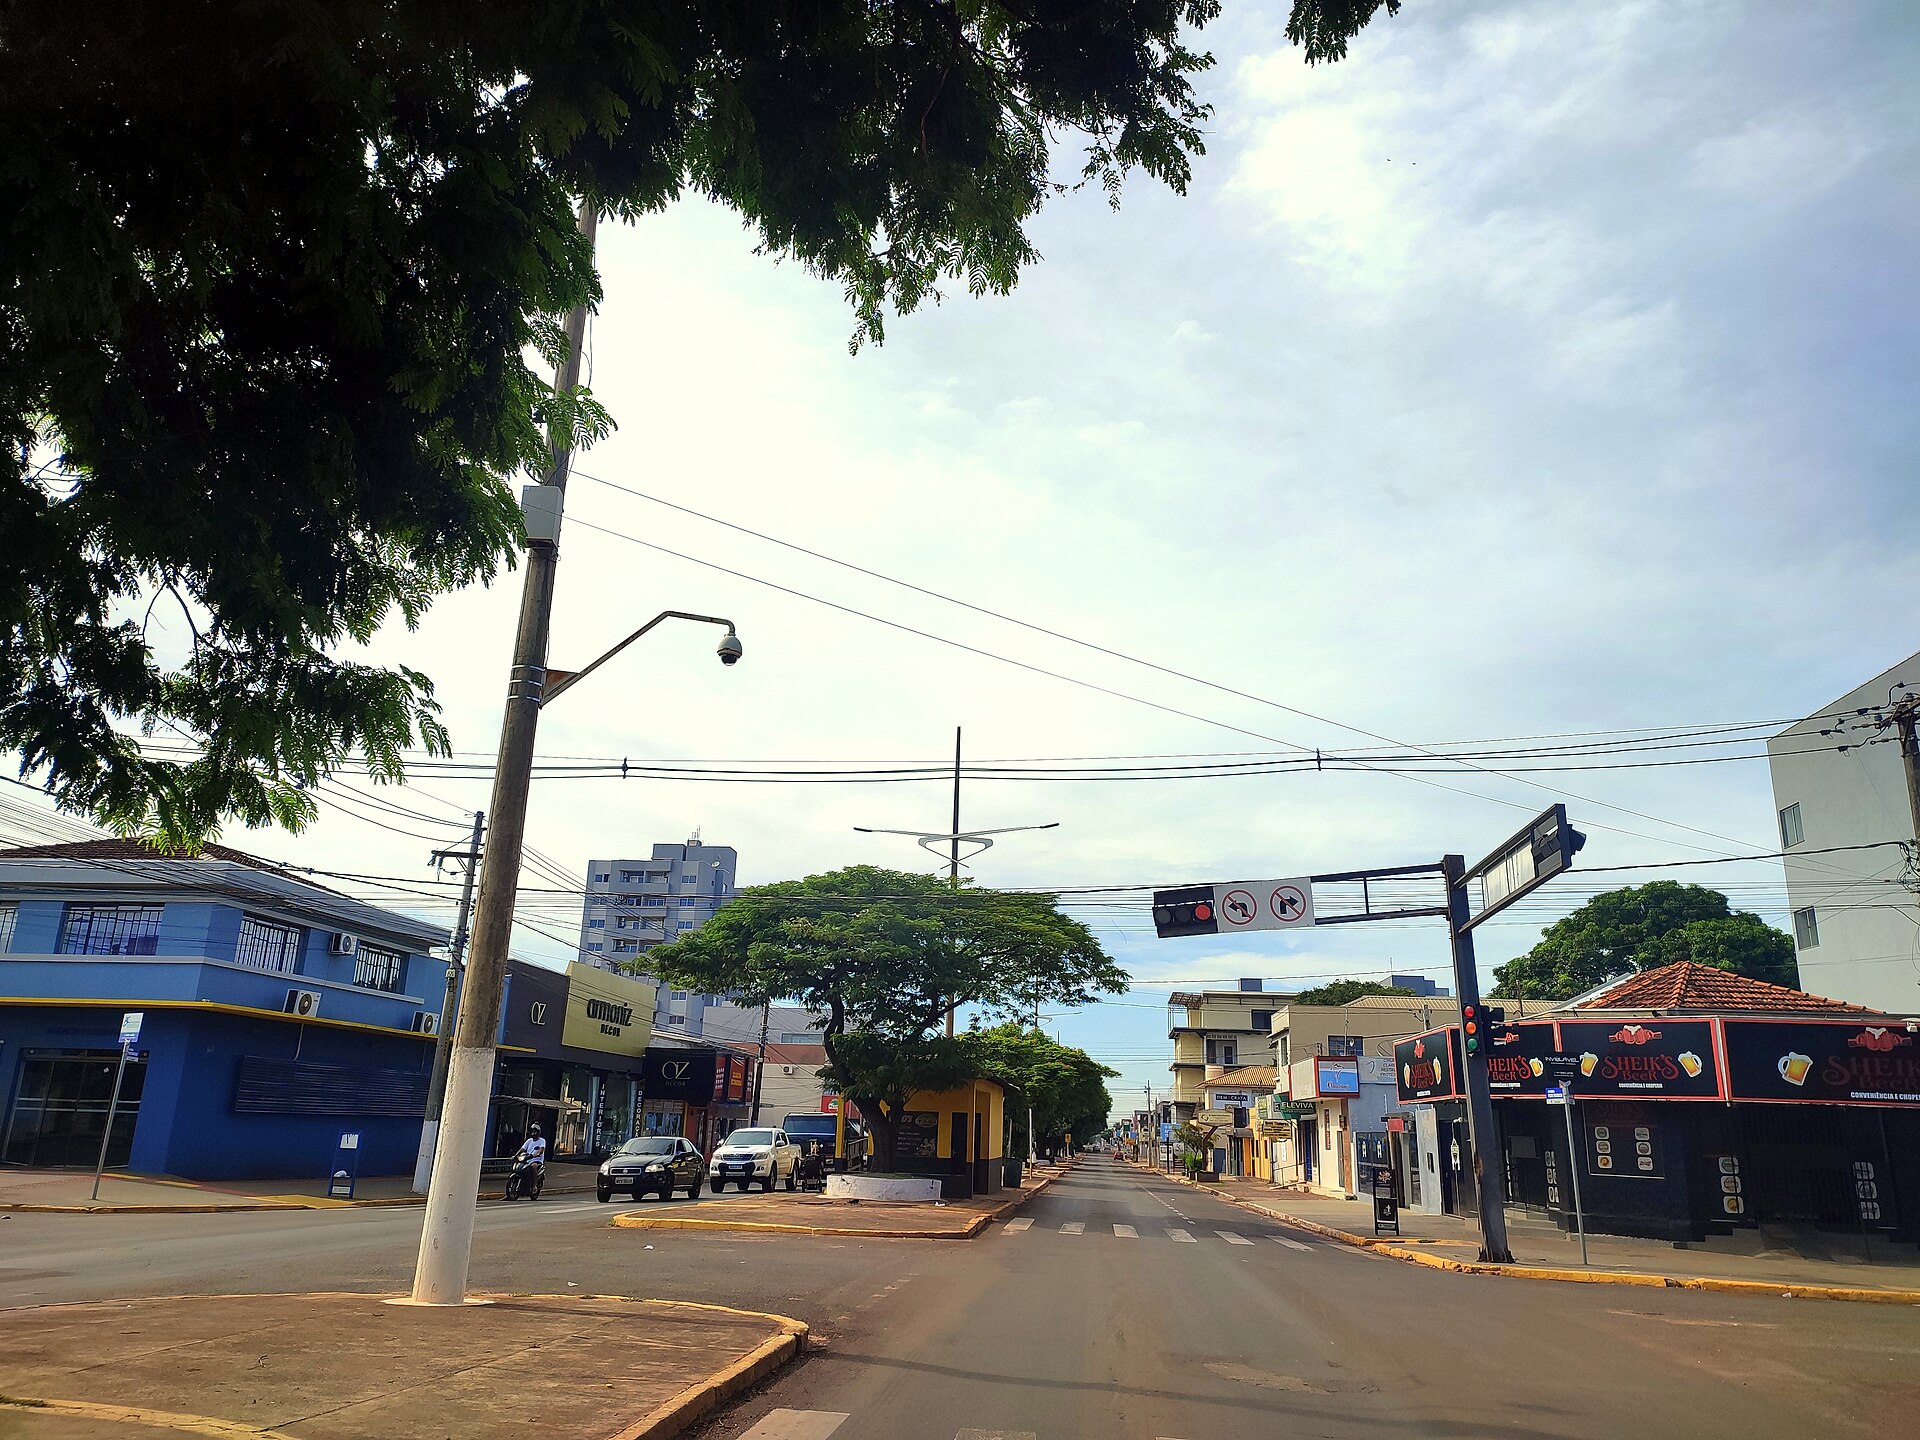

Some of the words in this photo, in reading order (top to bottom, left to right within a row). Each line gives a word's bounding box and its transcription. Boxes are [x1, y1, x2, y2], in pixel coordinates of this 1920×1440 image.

[600, 1023, 621, 1037] DECOR
[1487, 1055, 1532, 1079] HEIK'S
[1601, 1054, 1680, 1080] SHEIK'S
[1850, 1091, 1894, 1100] CONVENIÊNCIA
[595, 1083, 606, 1147] INTERIORES
